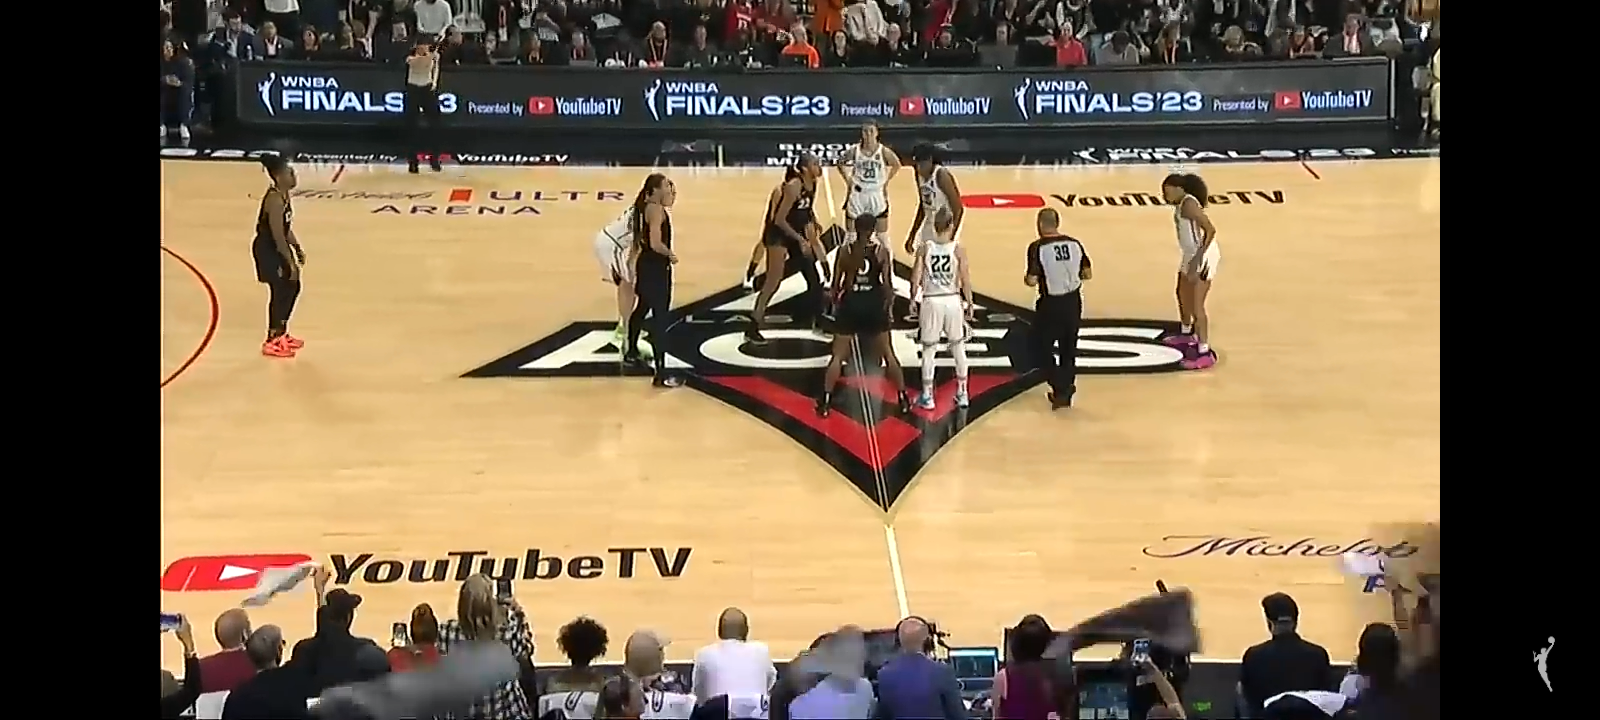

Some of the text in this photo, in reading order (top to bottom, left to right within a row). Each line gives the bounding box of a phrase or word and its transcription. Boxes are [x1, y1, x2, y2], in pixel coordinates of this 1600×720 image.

[281, 76, 339, 88] WNBA
[665, 82, 719, 93] WNBA
[1035, 80, 1089, 91] WNBA
[468, 101, 510, 114] Presented
[512, 102, 524, 116] by
[841, 103, 882, 116] Presented
[884, 103, 895, 117] by
[1213, 98, 1256, 112] Presented
[1257, 98, 1270, 112] by
[489, 190, 625, 201] ULTR
[371, 204, 541, 215] ARENA
[930, 254, 951, 272] 22
